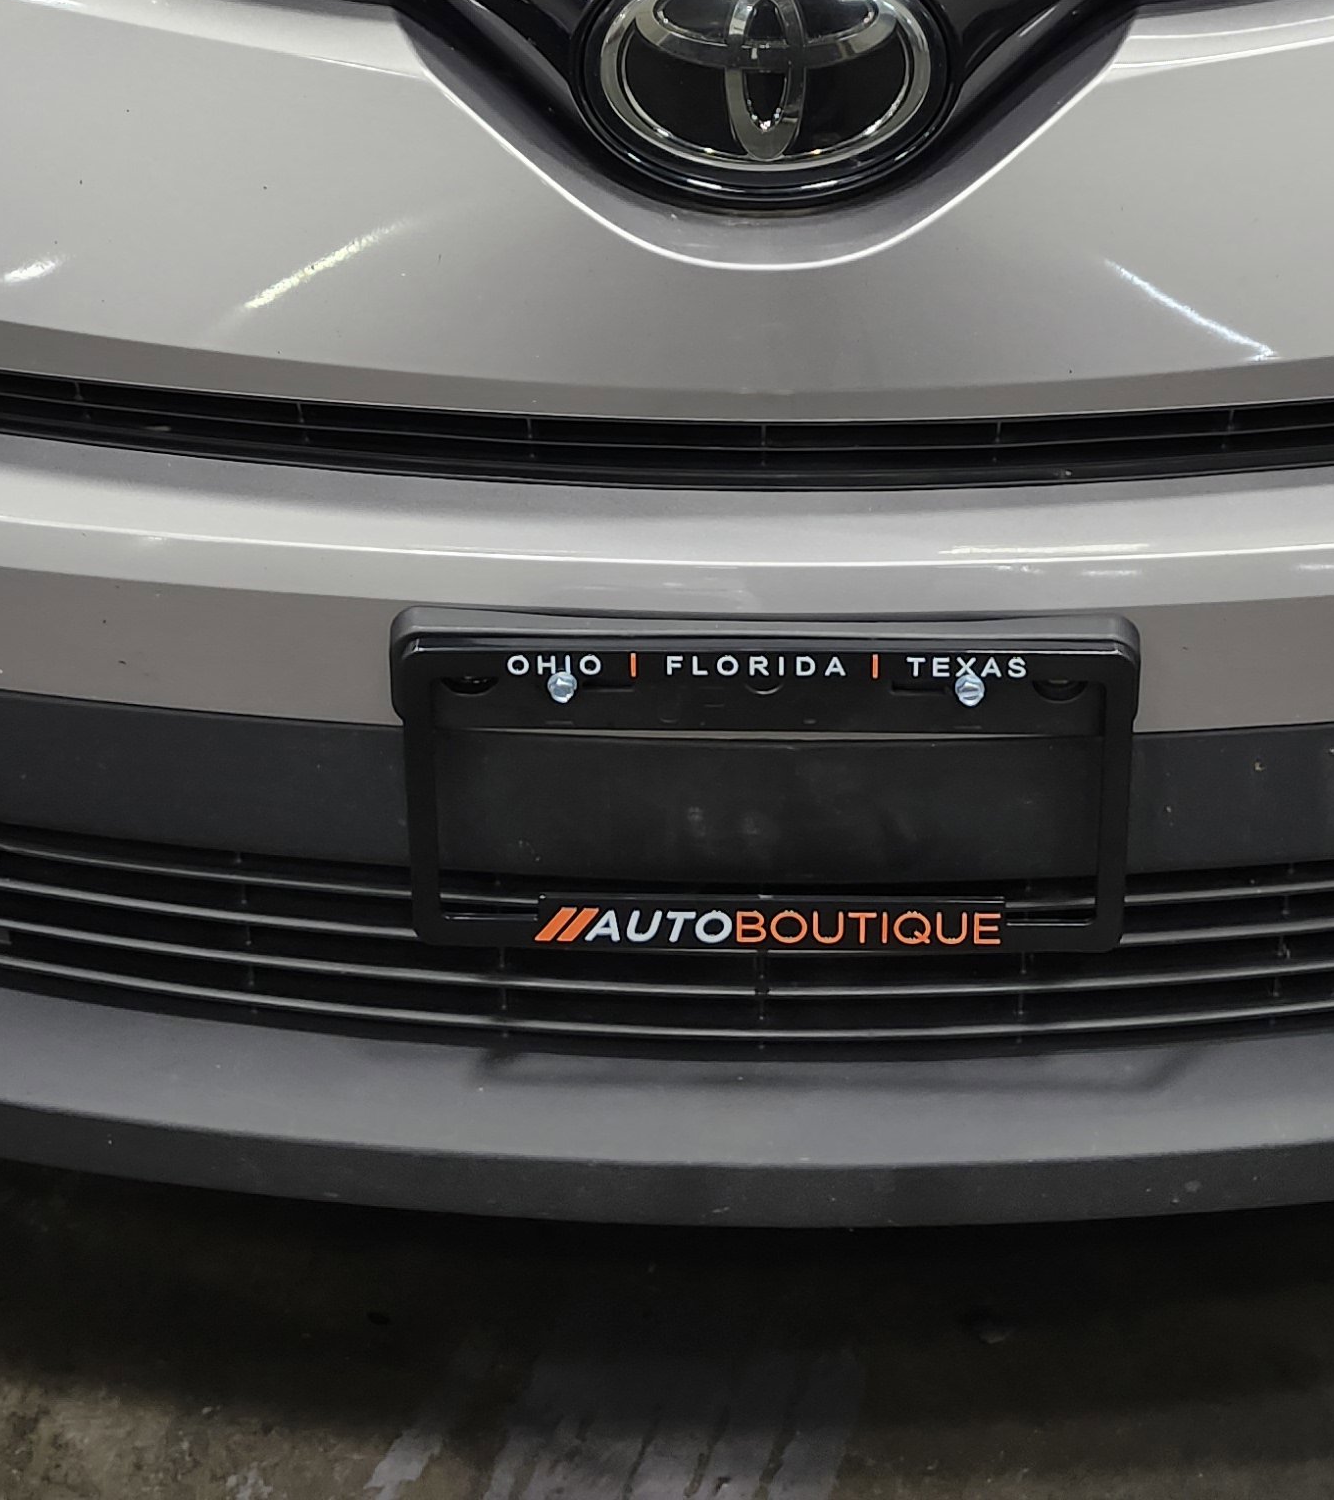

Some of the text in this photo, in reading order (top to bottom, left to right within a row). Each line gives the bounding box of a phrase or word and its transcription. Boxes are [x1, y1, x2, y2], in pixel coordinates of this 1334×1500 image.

[506, 653, 1028, 678] OHIO FLORIDA TEXAS
[584, 909, 1002, 945] AUTOBOUTIQUE
